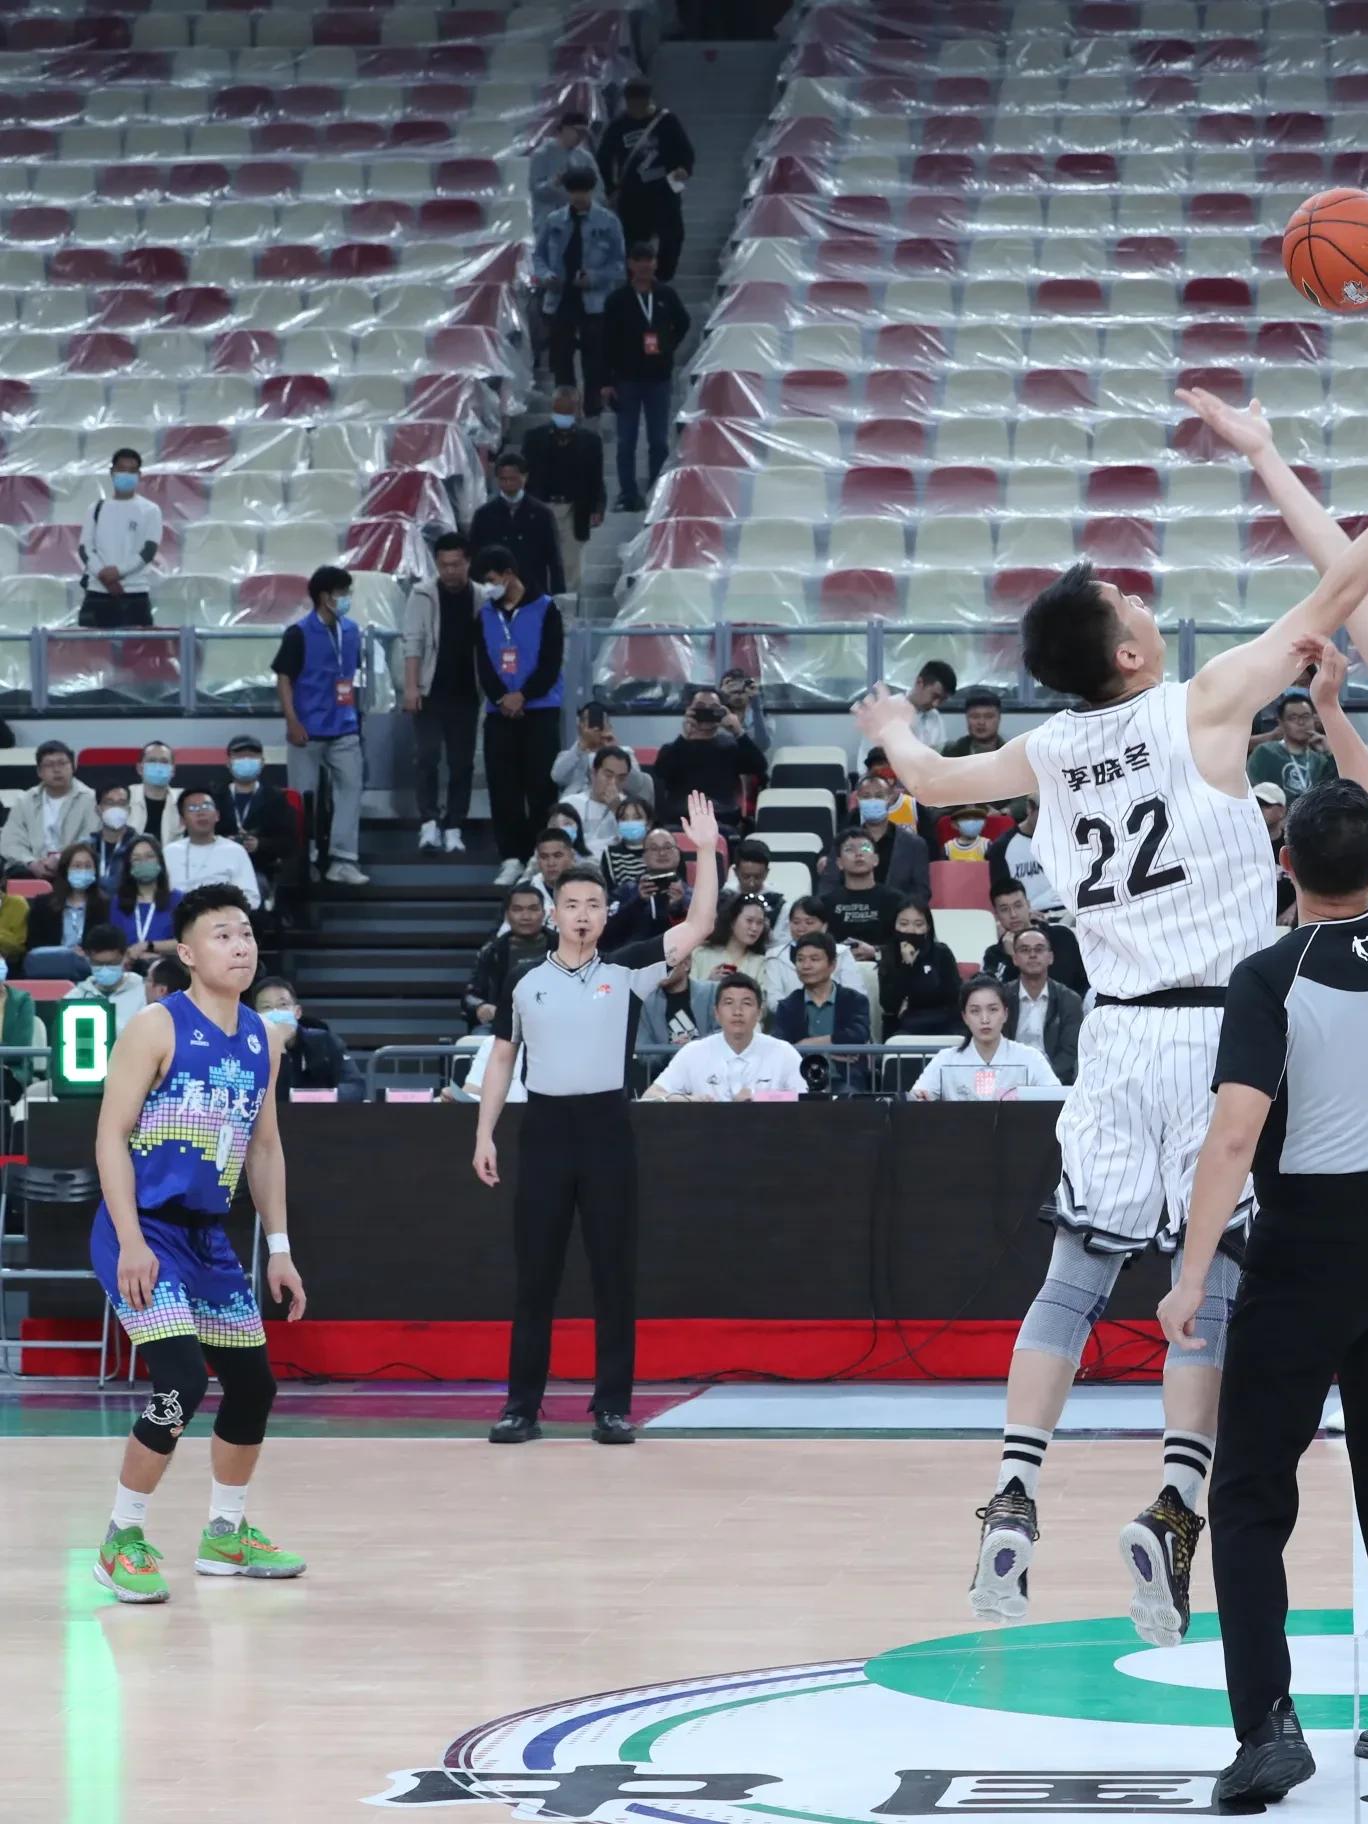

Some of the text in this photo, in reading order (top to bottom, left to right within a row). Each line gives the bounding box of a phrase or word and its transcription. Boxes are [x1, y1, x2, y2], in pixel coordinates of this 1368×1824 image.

[1061, 742, 1150, 793] 李晓冬
[1072, 791, 1191, 914] 22
[62, 1005, 107, 1082] 0
